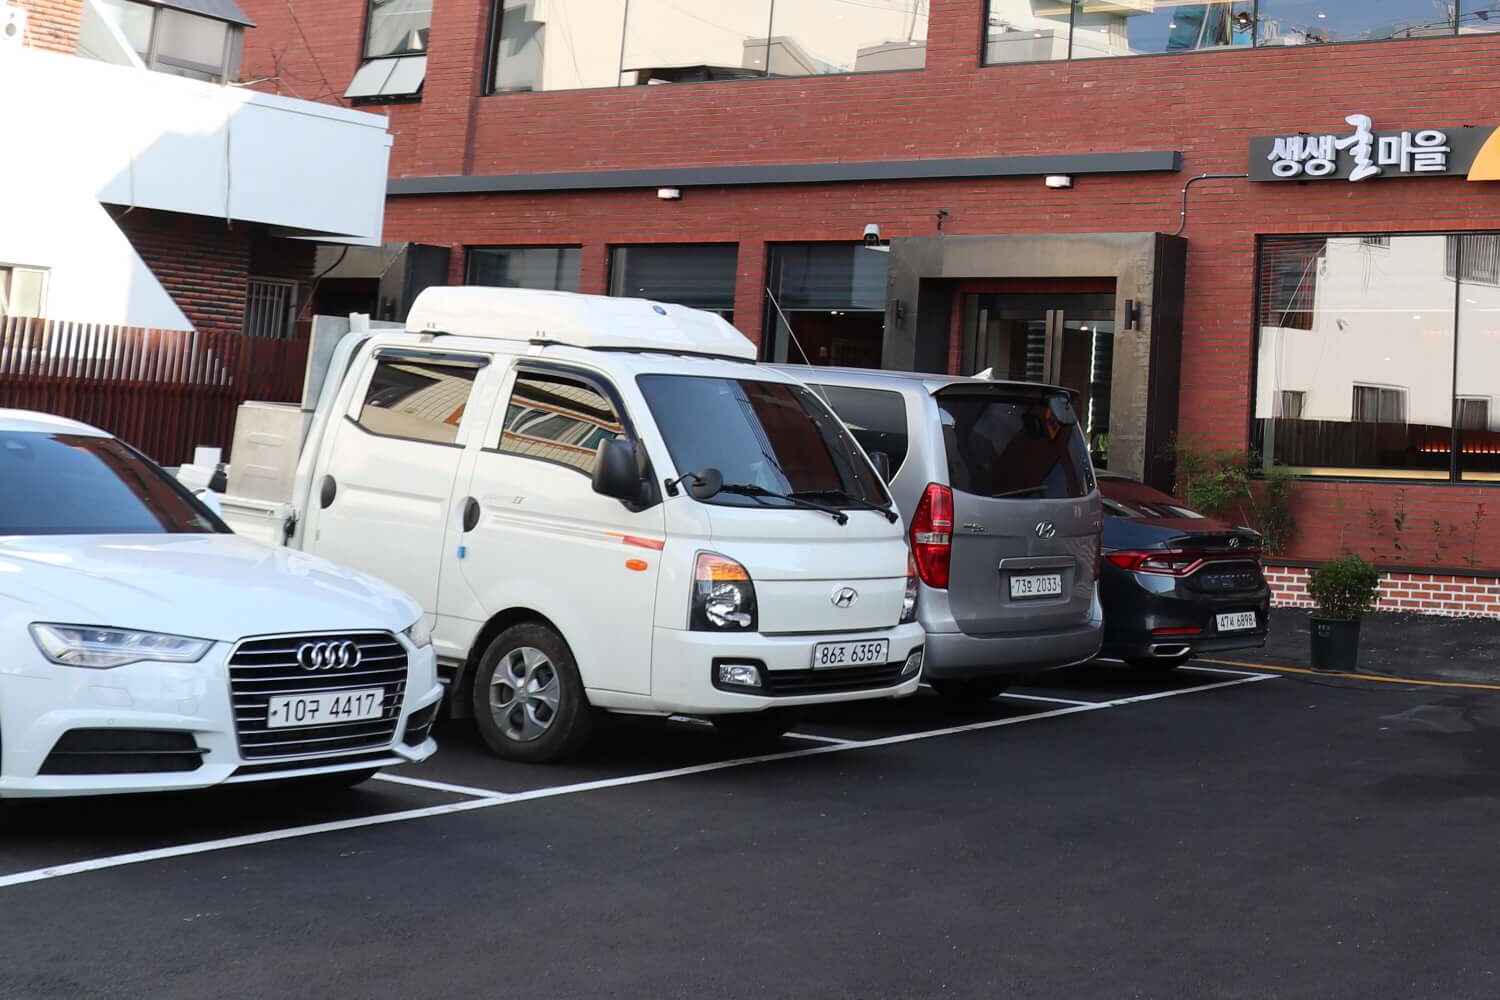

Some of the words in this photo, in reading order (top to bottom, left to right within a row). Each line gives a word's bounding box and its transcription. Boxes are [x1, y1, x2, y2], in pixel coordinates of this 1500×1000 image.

[1267, 113, 1451, 182] 생생굴마을
[1036, 577, 1057, 593] 2033
[820, 646, 846, 665] 86조
[850, 642, 882, 663] 6359
[282, 699, 320, 723] 10구
[329, 693, 375, 718] 4417
